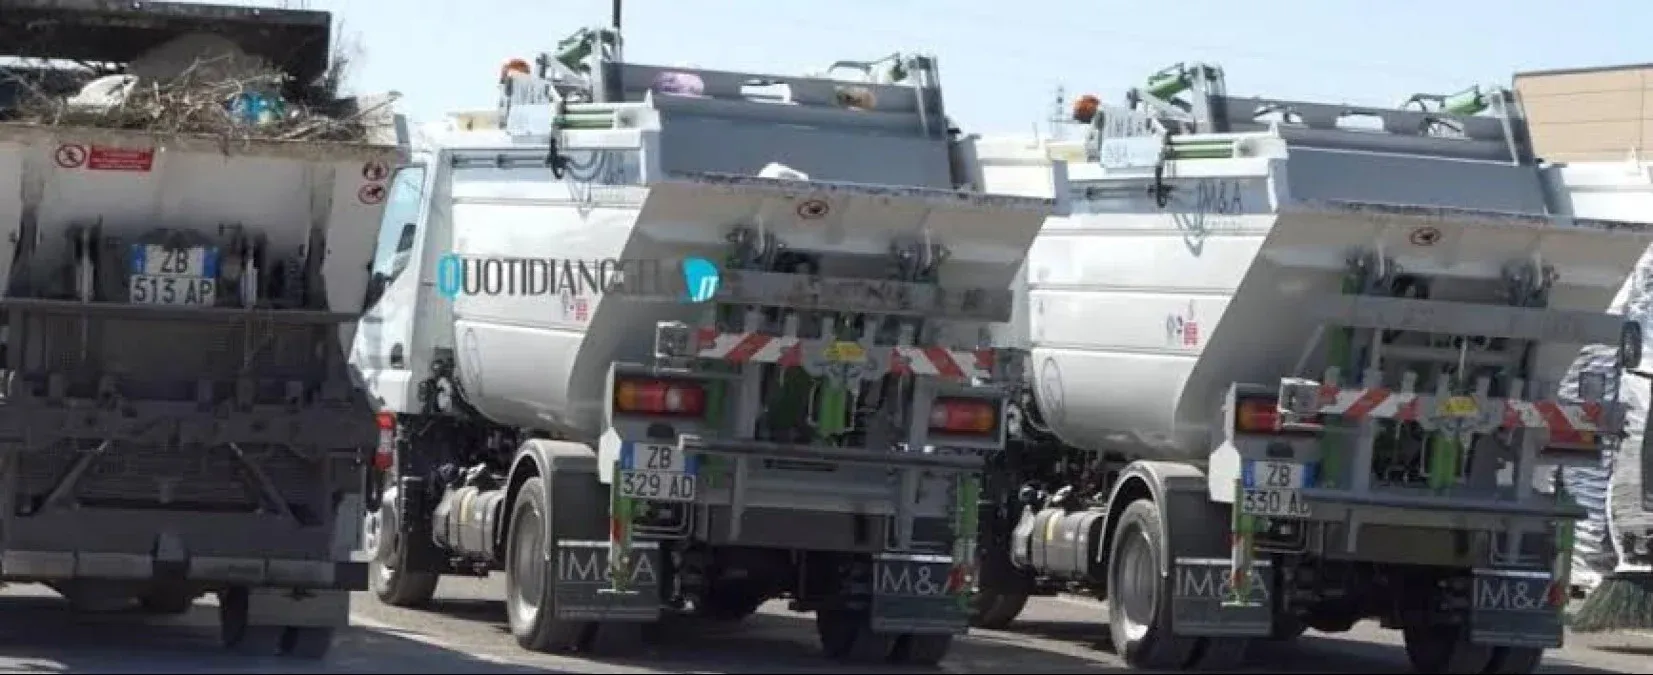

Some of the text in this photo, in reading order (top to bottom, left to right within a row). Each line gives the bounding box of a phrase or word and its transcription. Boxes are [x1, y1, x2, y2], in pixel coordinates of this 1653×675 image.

[161, 247, 189, 273] ZB
[134, 277, 213, 304] 513 AP
[647, 445, 672, 469] ZB
[622, 472, 693, 498] 329 AD
[1266, 463, 1291, 487] ZB
[1244, 489, 1280, 512] 330
